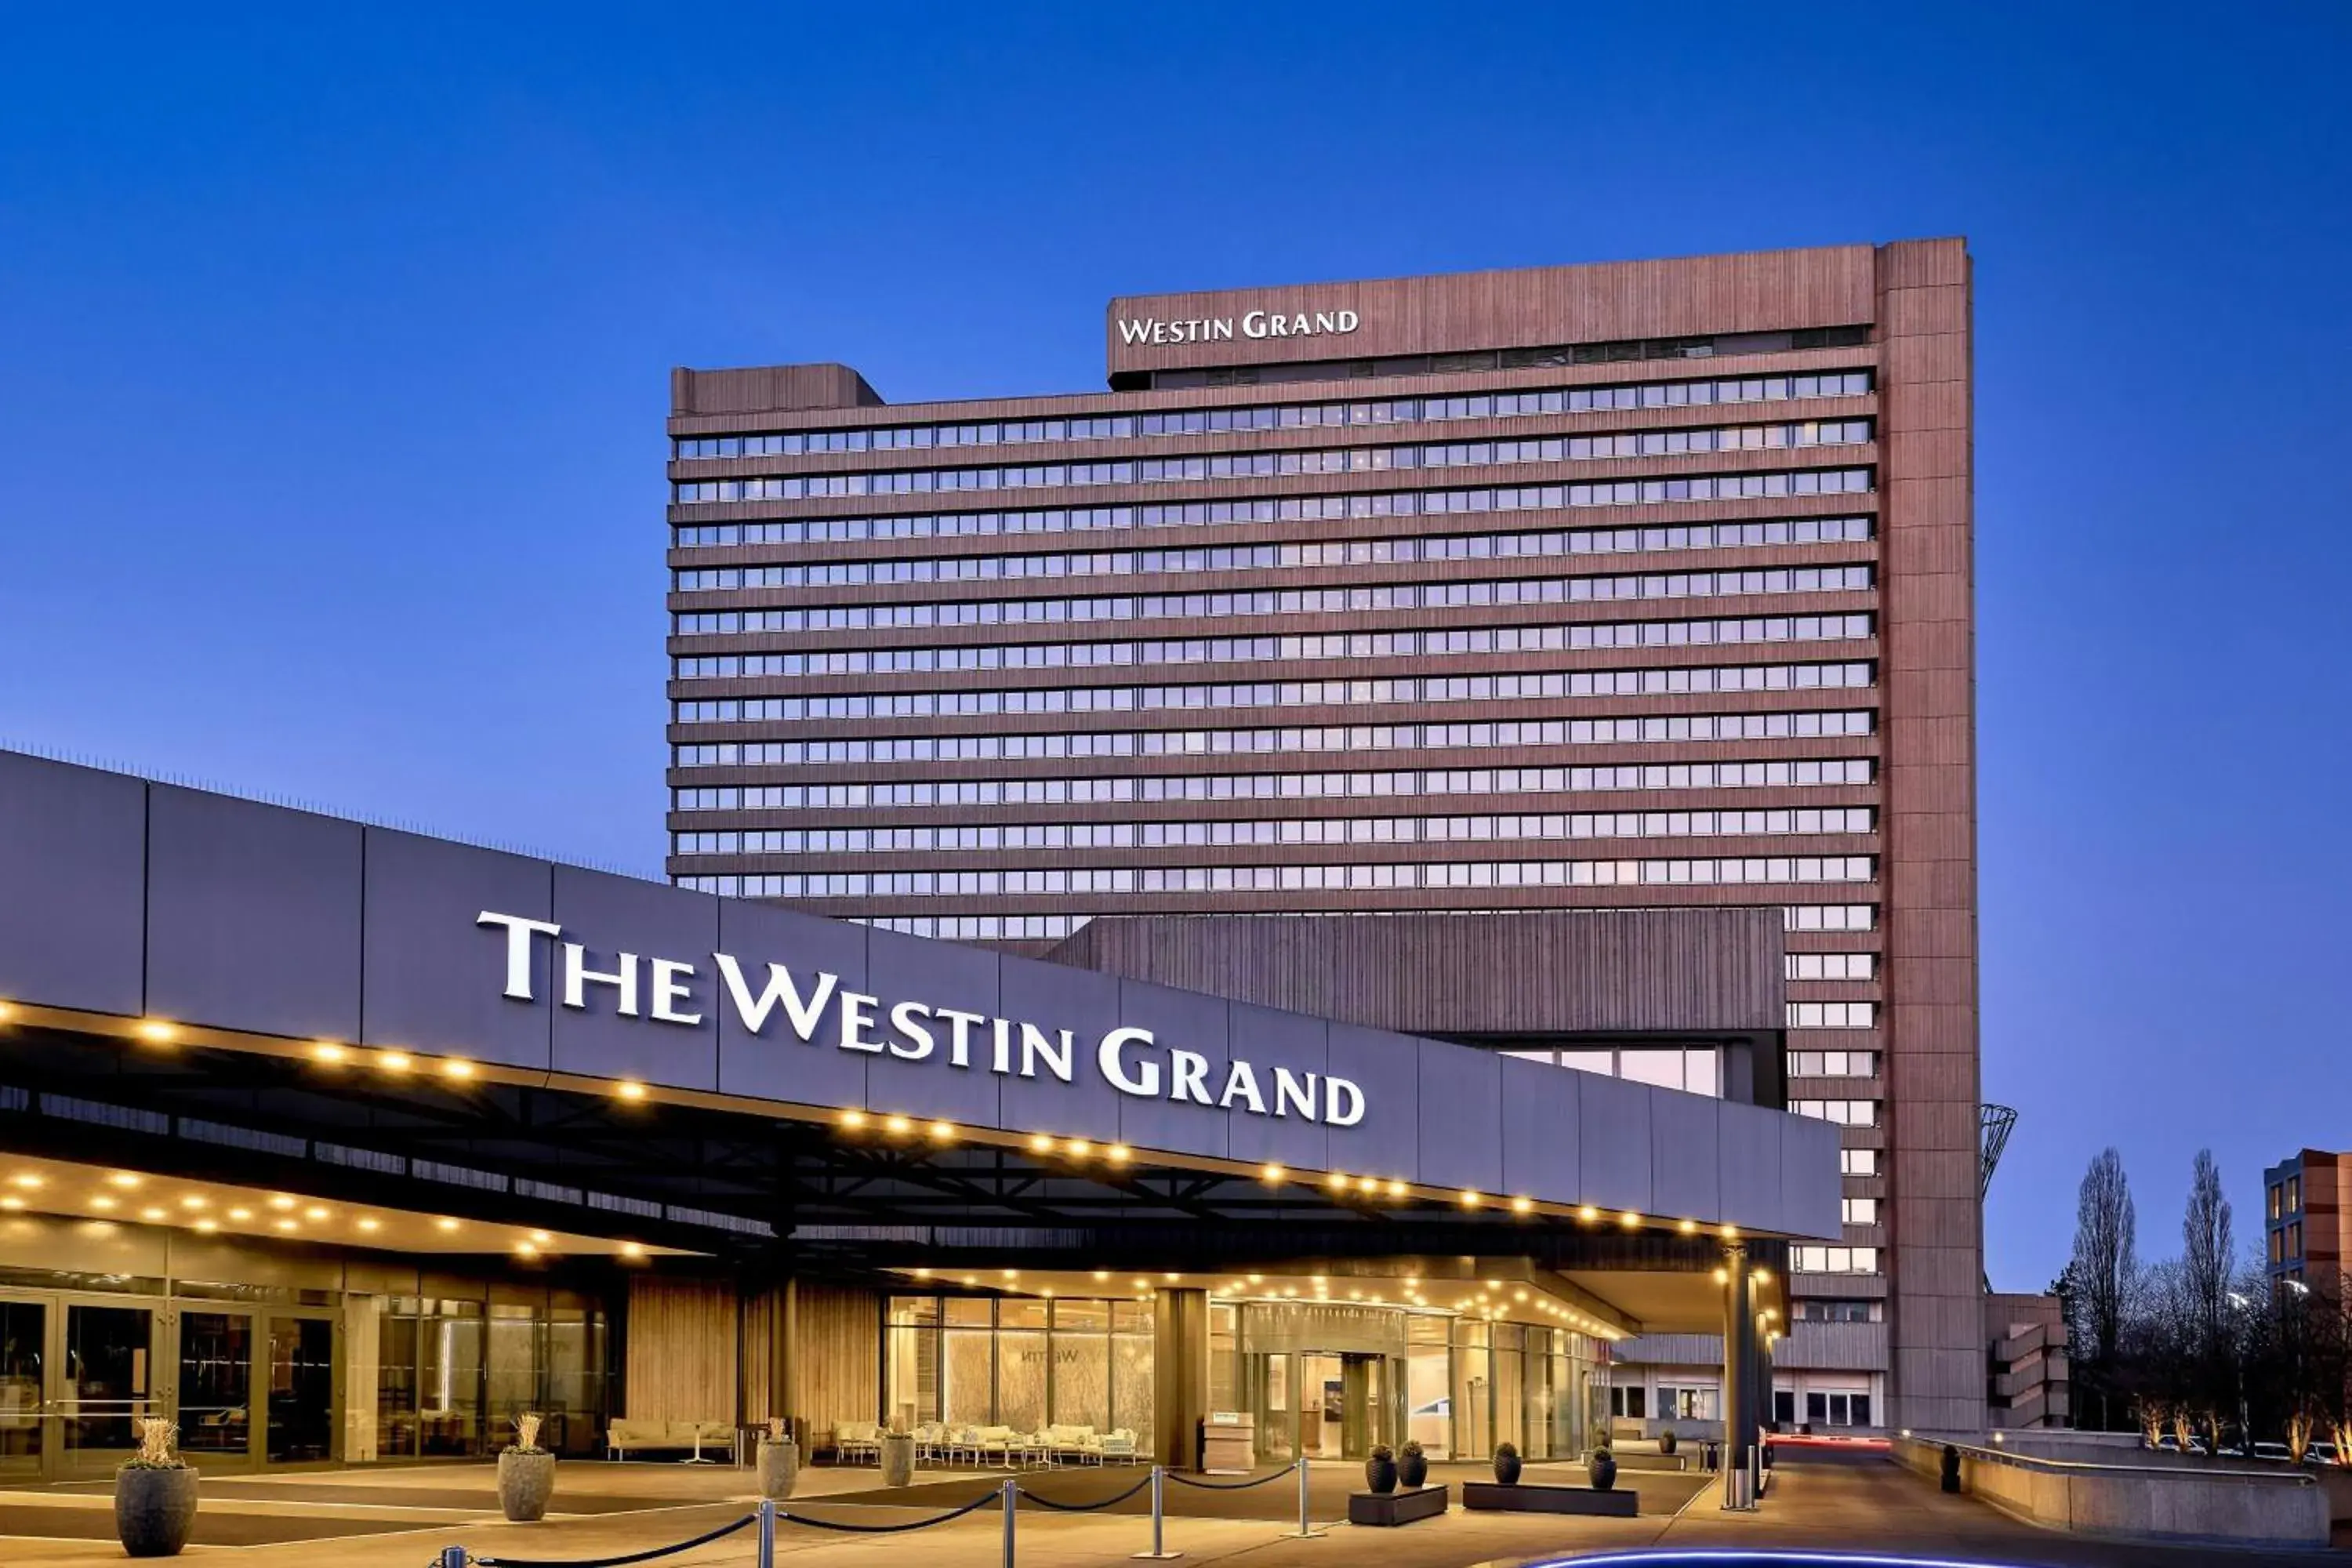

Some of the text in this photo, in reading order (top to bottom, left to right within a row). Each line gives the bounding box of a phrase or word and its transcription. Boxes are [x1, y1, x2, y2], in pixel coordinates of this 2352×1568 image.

[1118, 310, 1359, 345] WESTIN GRAND
[476, 909, 1366, 1127] THE WESTIN GRAND
